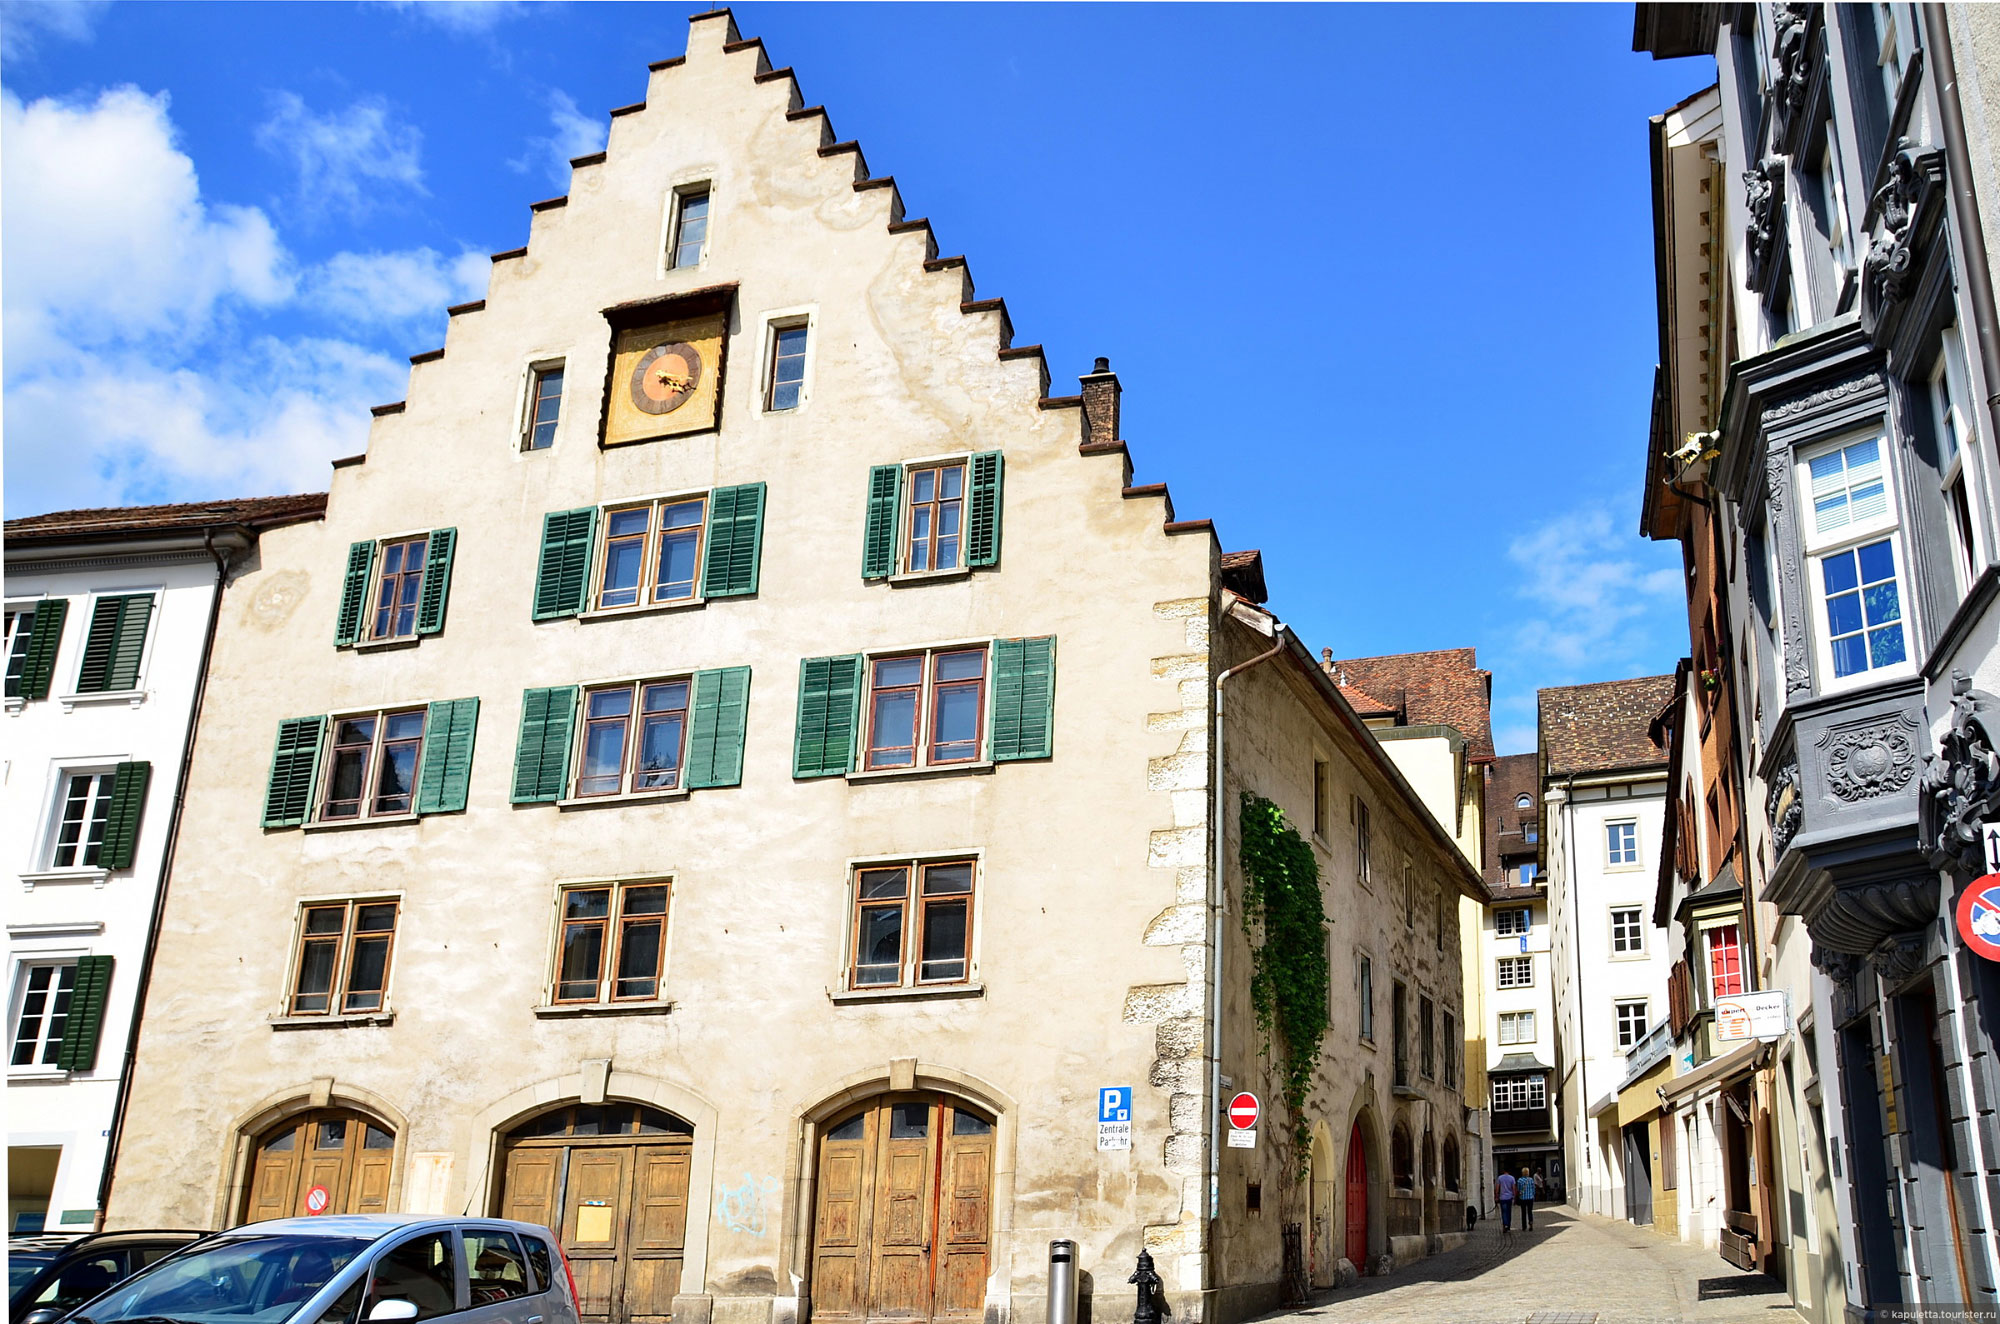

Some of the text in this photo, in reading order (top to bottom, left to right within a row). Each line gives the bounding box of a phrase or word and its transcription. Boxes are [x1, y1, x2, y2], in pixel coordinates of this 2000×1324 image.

[1104, 1090, 1121, 1118] P
[1100, 1124, 1129, 1134] Zentrale
[1100, 1136, 1128, 1147] Pahr
